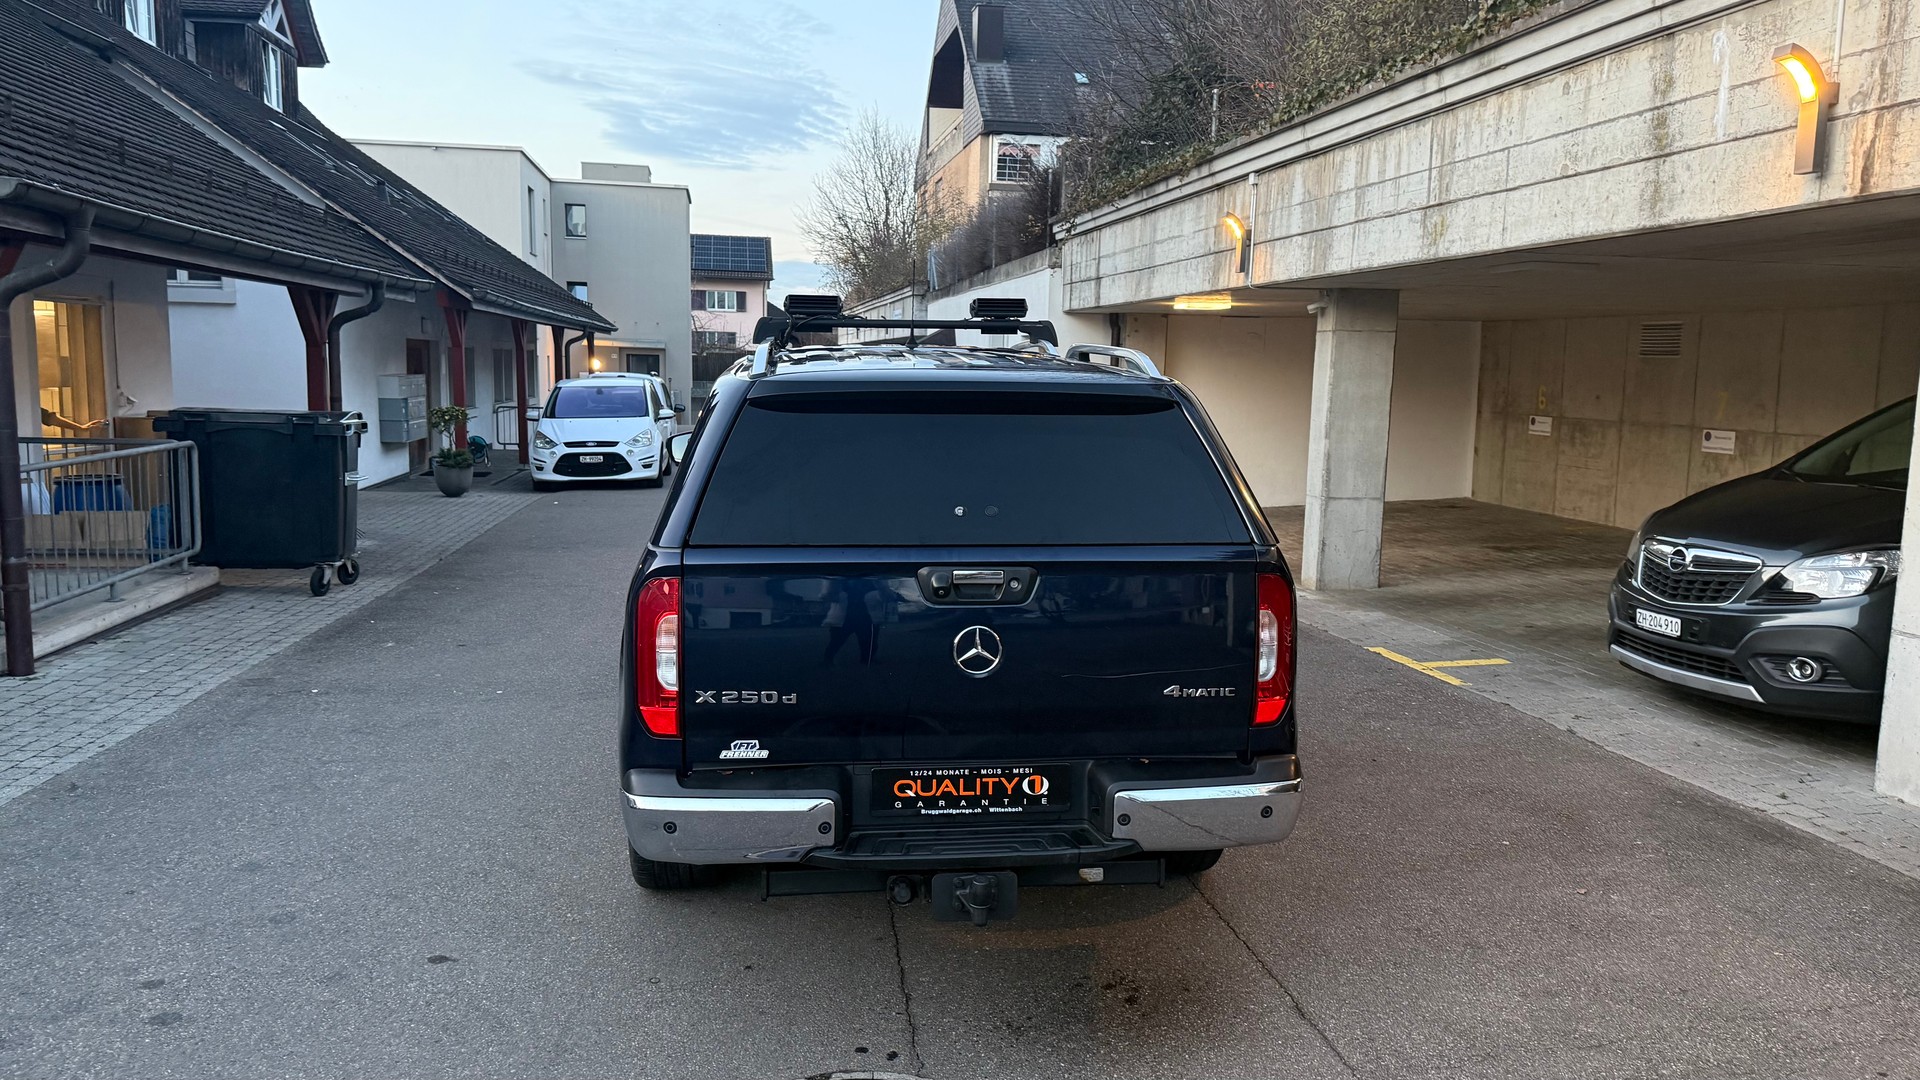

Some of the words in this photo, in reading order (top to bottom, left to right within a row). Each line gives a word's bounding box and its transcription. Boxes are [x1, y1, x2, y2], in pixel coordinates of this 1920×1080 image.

[1538, 385, 1547, 410] 6
[695, 690, 717, 704] X
[1163, 684, 1236, 698] 4MATIC
[893, 776, 1020, 798] QUALITY
[894, 797, 1048, 809] GARANTIE
[921, 807, 982, 815] Bruggwaldgarage.ch
